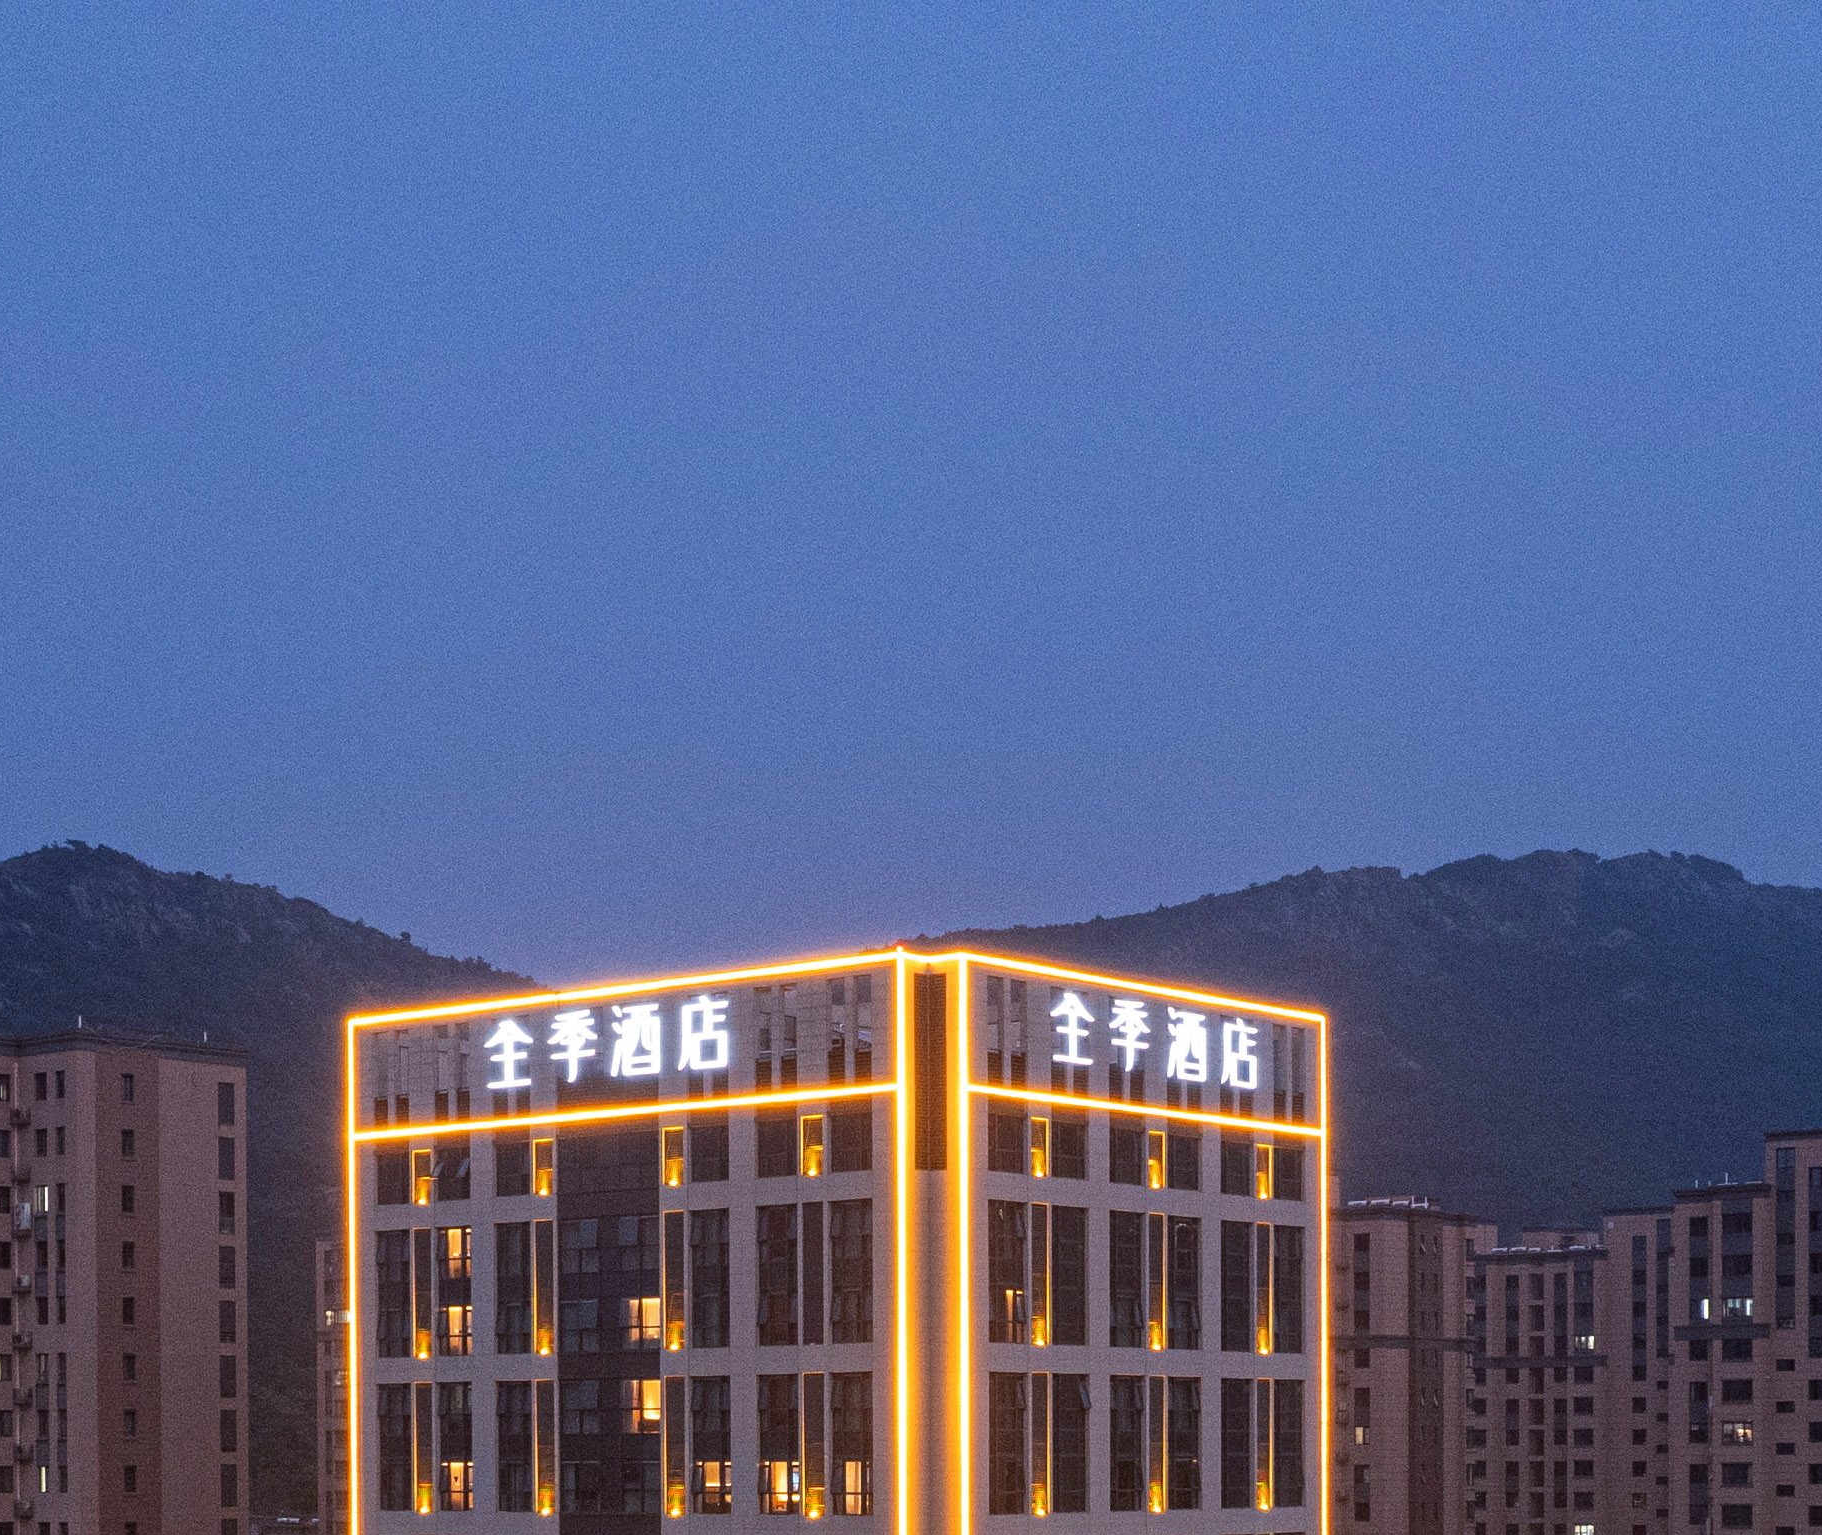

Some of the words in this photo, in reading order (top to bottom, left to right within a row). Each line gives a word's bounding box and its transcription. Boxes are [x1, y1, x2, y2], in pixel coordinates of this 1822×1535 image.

[483, 995, 730, 1089] 全季酒店
[1049, 991, 1259, 1090] 全季酒店
